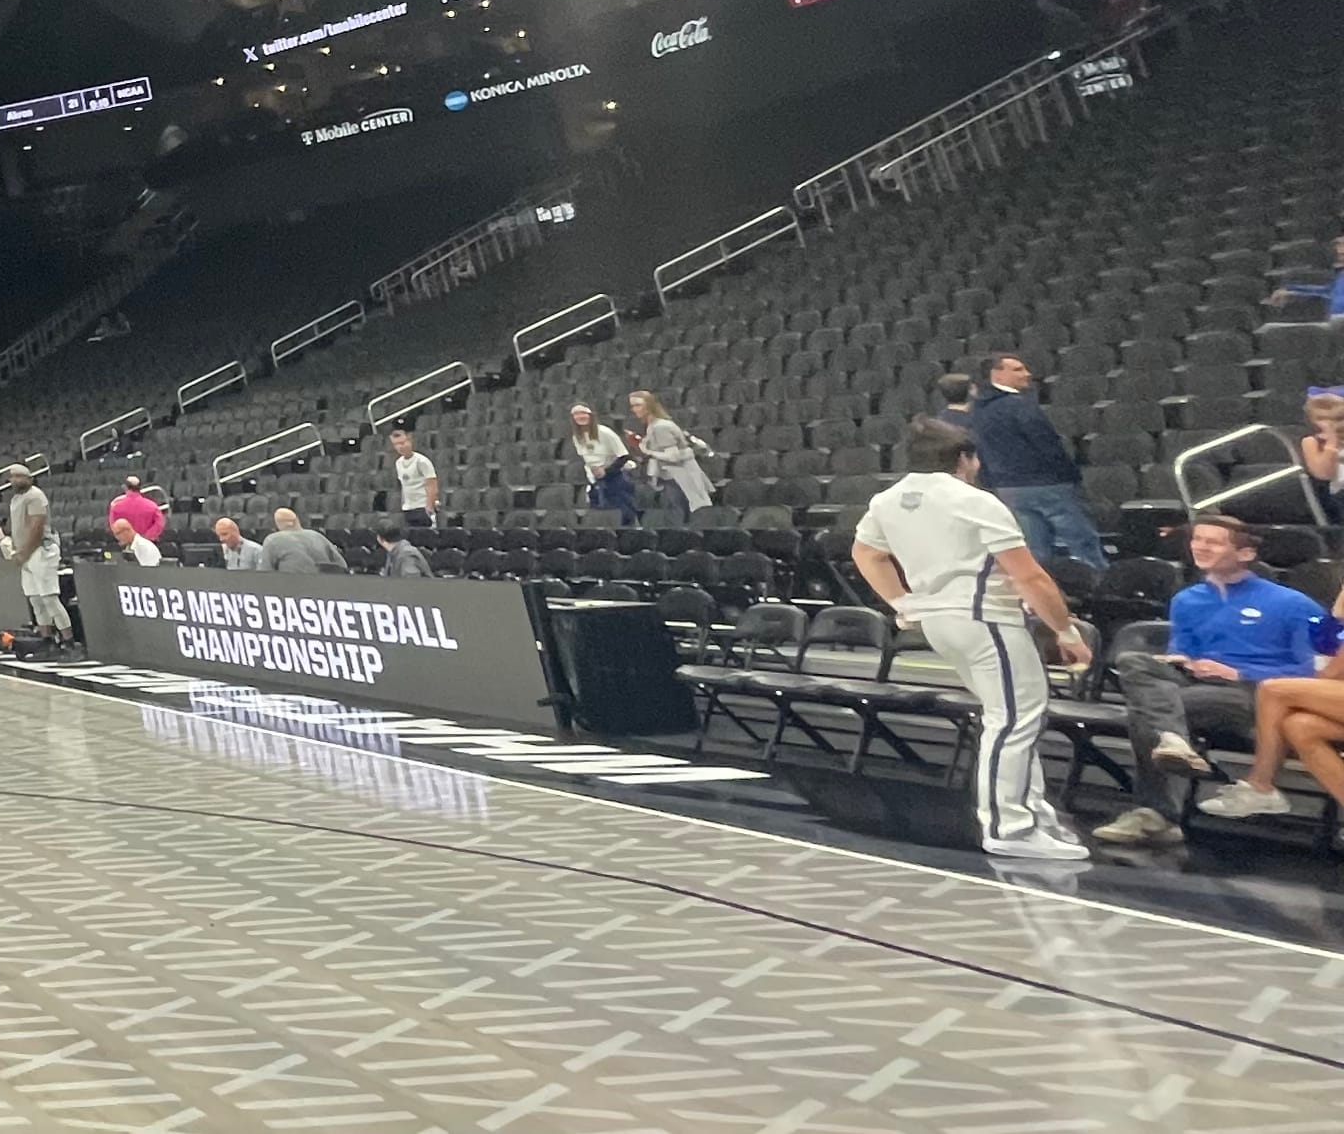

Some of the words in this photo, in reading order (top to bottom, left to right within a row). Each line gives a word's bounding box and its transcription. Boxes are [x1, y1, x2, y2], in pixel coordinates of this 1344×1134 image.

[470, 80, 524, 103] KONICA
[526, 64, 591, 89] MINOLTA
[316, 122, 360, 143] Mobile
[361, 108, 413, 132] CENTER
[118, 585, 157, 618] BIG
[157, 588, 187, 621] 12
[186, 590, 263, 630] MEN'S
[264, 595, 458, 650] BASKETBALL
[176, 625, 384, 684] CHAMPIONSHIP
